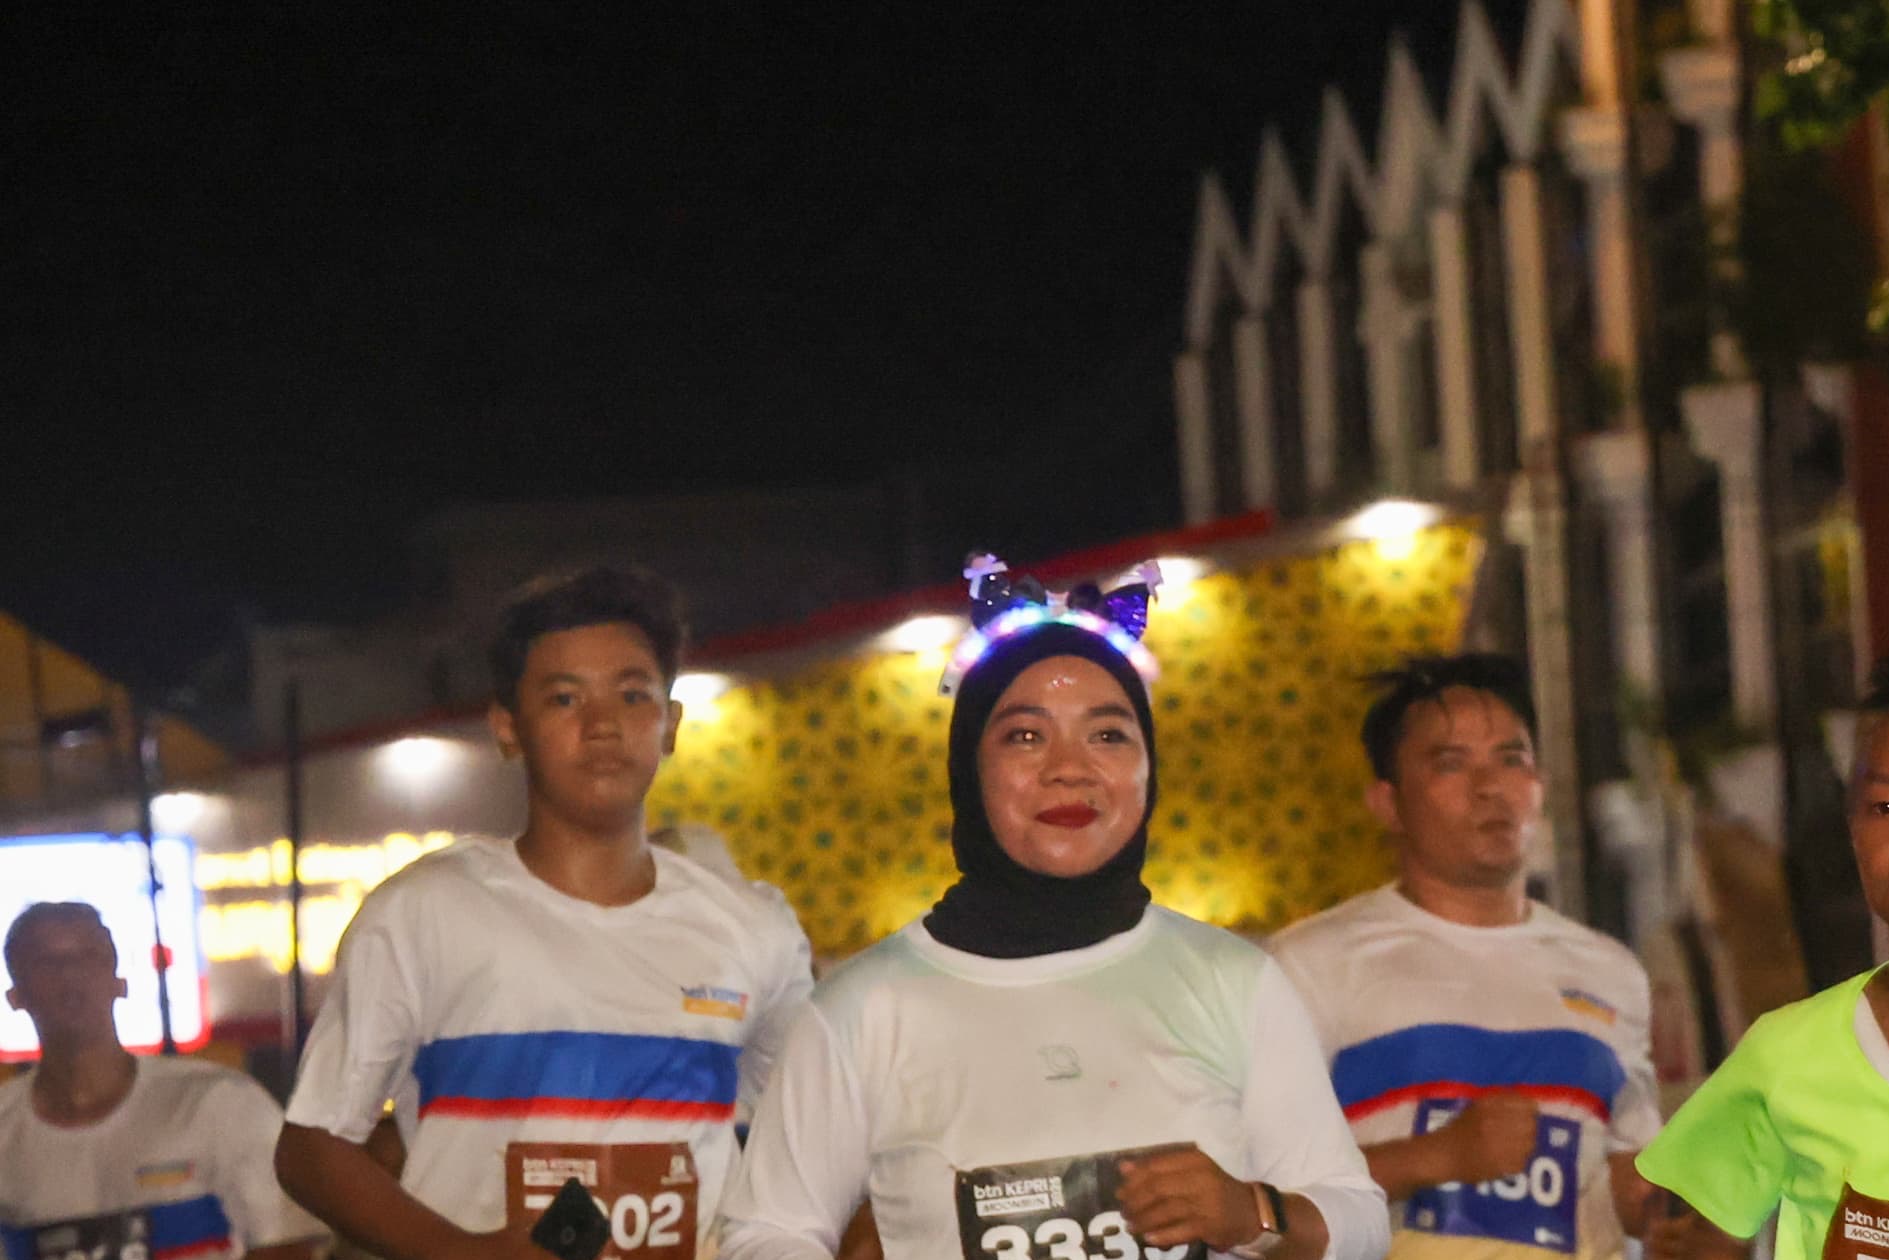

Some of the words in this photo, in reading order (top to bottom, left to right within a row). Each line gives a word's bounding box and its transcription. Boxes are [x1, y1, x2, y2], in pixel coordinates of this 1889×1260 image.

[973, 1184, 1003, 1200] btn
[1005, 1177, 1049, 1196] KEPRI
[1844, 1207, 1873, 1227] btn
